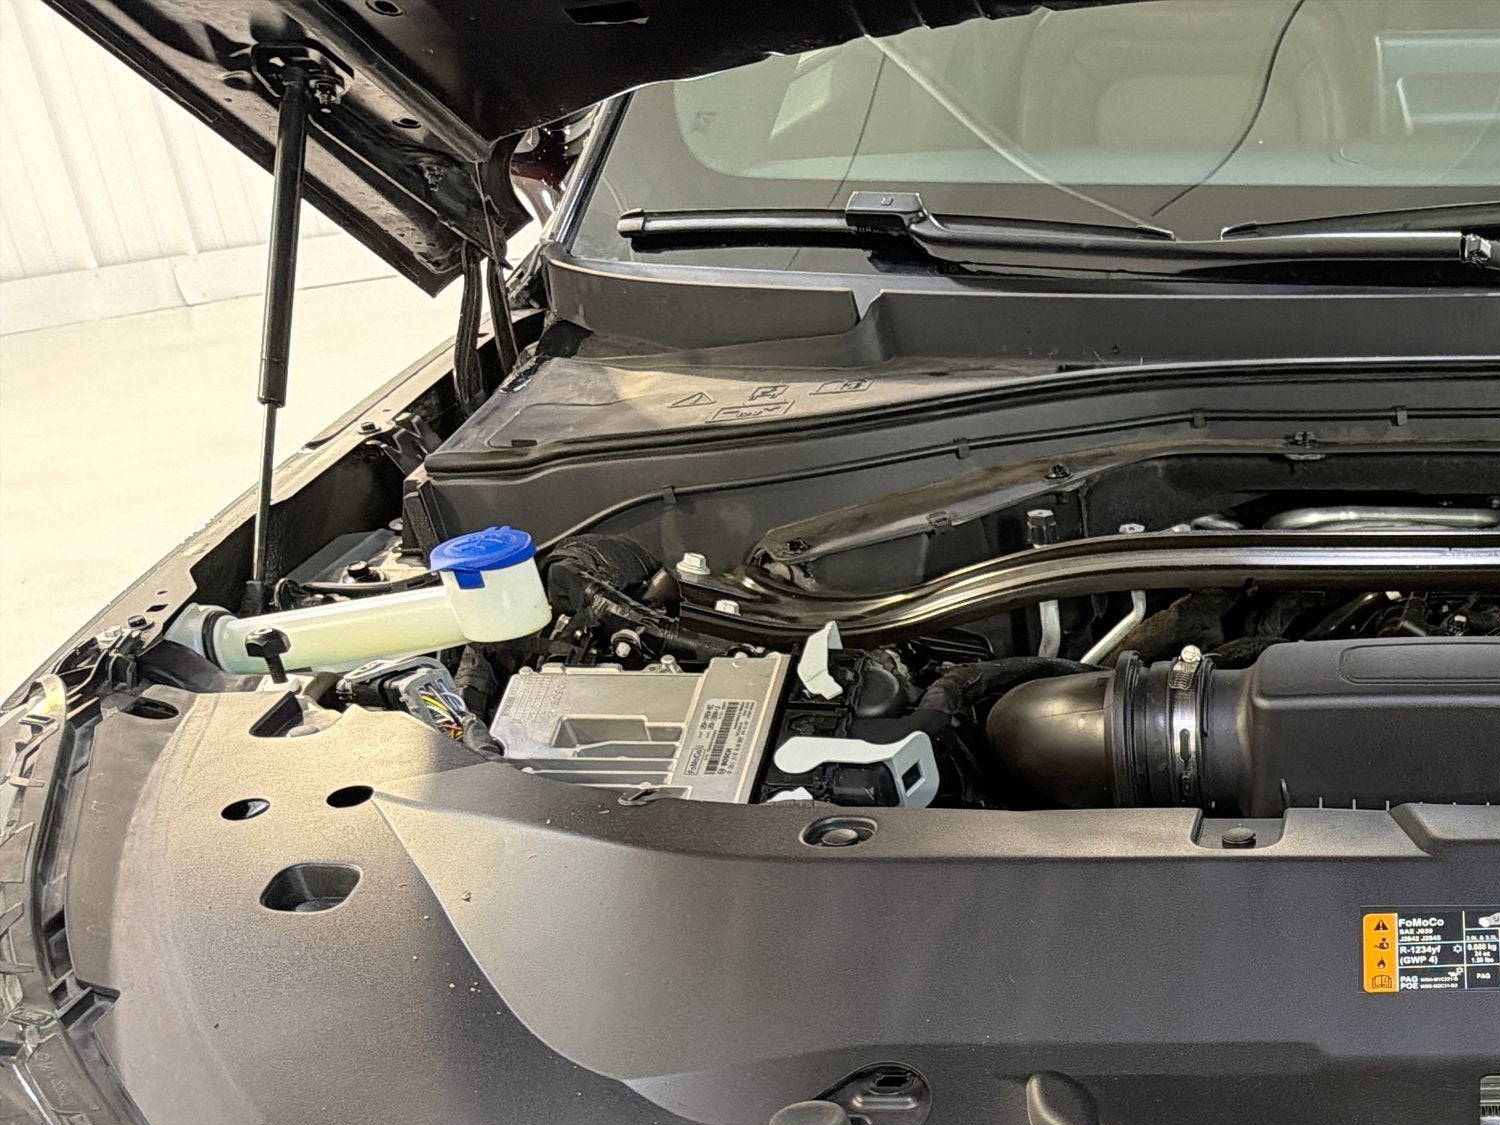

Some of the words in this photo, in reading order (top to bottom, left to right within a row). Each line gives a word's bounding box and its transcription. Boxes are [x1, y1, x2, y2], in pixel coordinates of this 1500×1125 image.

[720, 747, 732, 766] BOSCH
[1399, 917, 1444, 927] FoMoCo
[1400, 945, 1441, 955] R-1234yf
[1488, 943, 1497, 951] kg
[1400, 956, 1426, 966] (GWP
[1428, 955, 1438, 965] 4)
